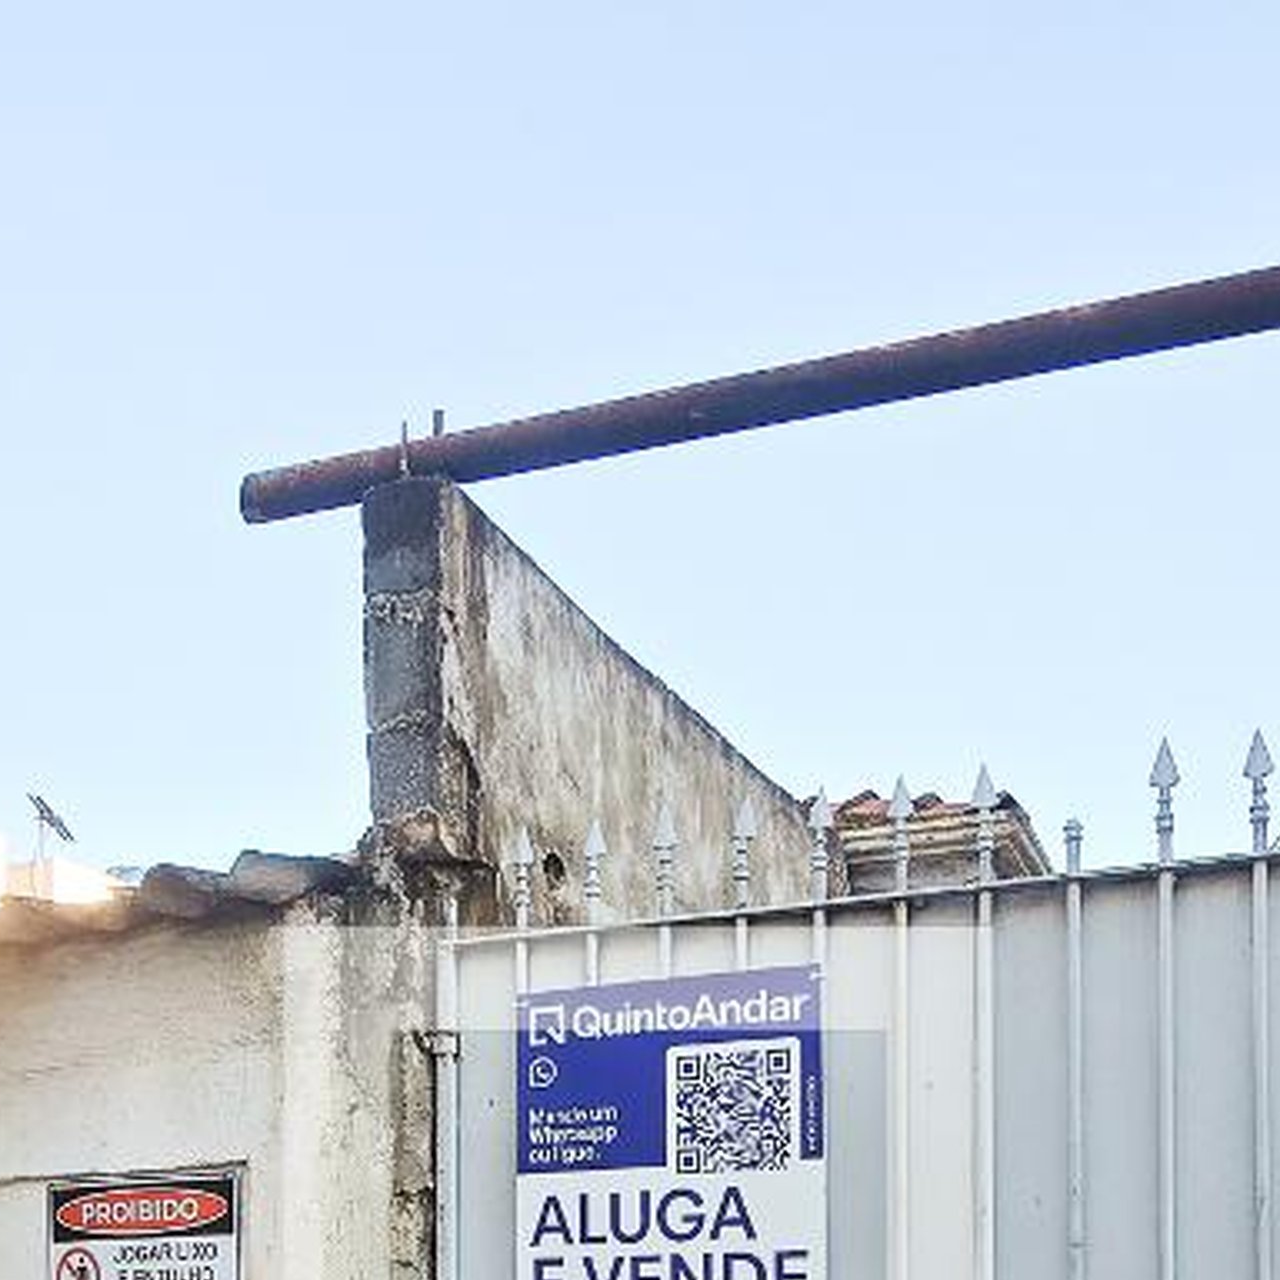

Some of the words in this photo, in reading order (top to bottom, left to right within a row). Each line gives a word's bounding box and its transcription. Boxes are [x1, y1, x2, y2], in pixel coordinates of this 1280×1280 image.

[572, 990, 810, 1040] QuintoAndar
[82, 1197, 199, 1225] PROIBIDO
[529, 1185, 757, 1247] ALUGA
